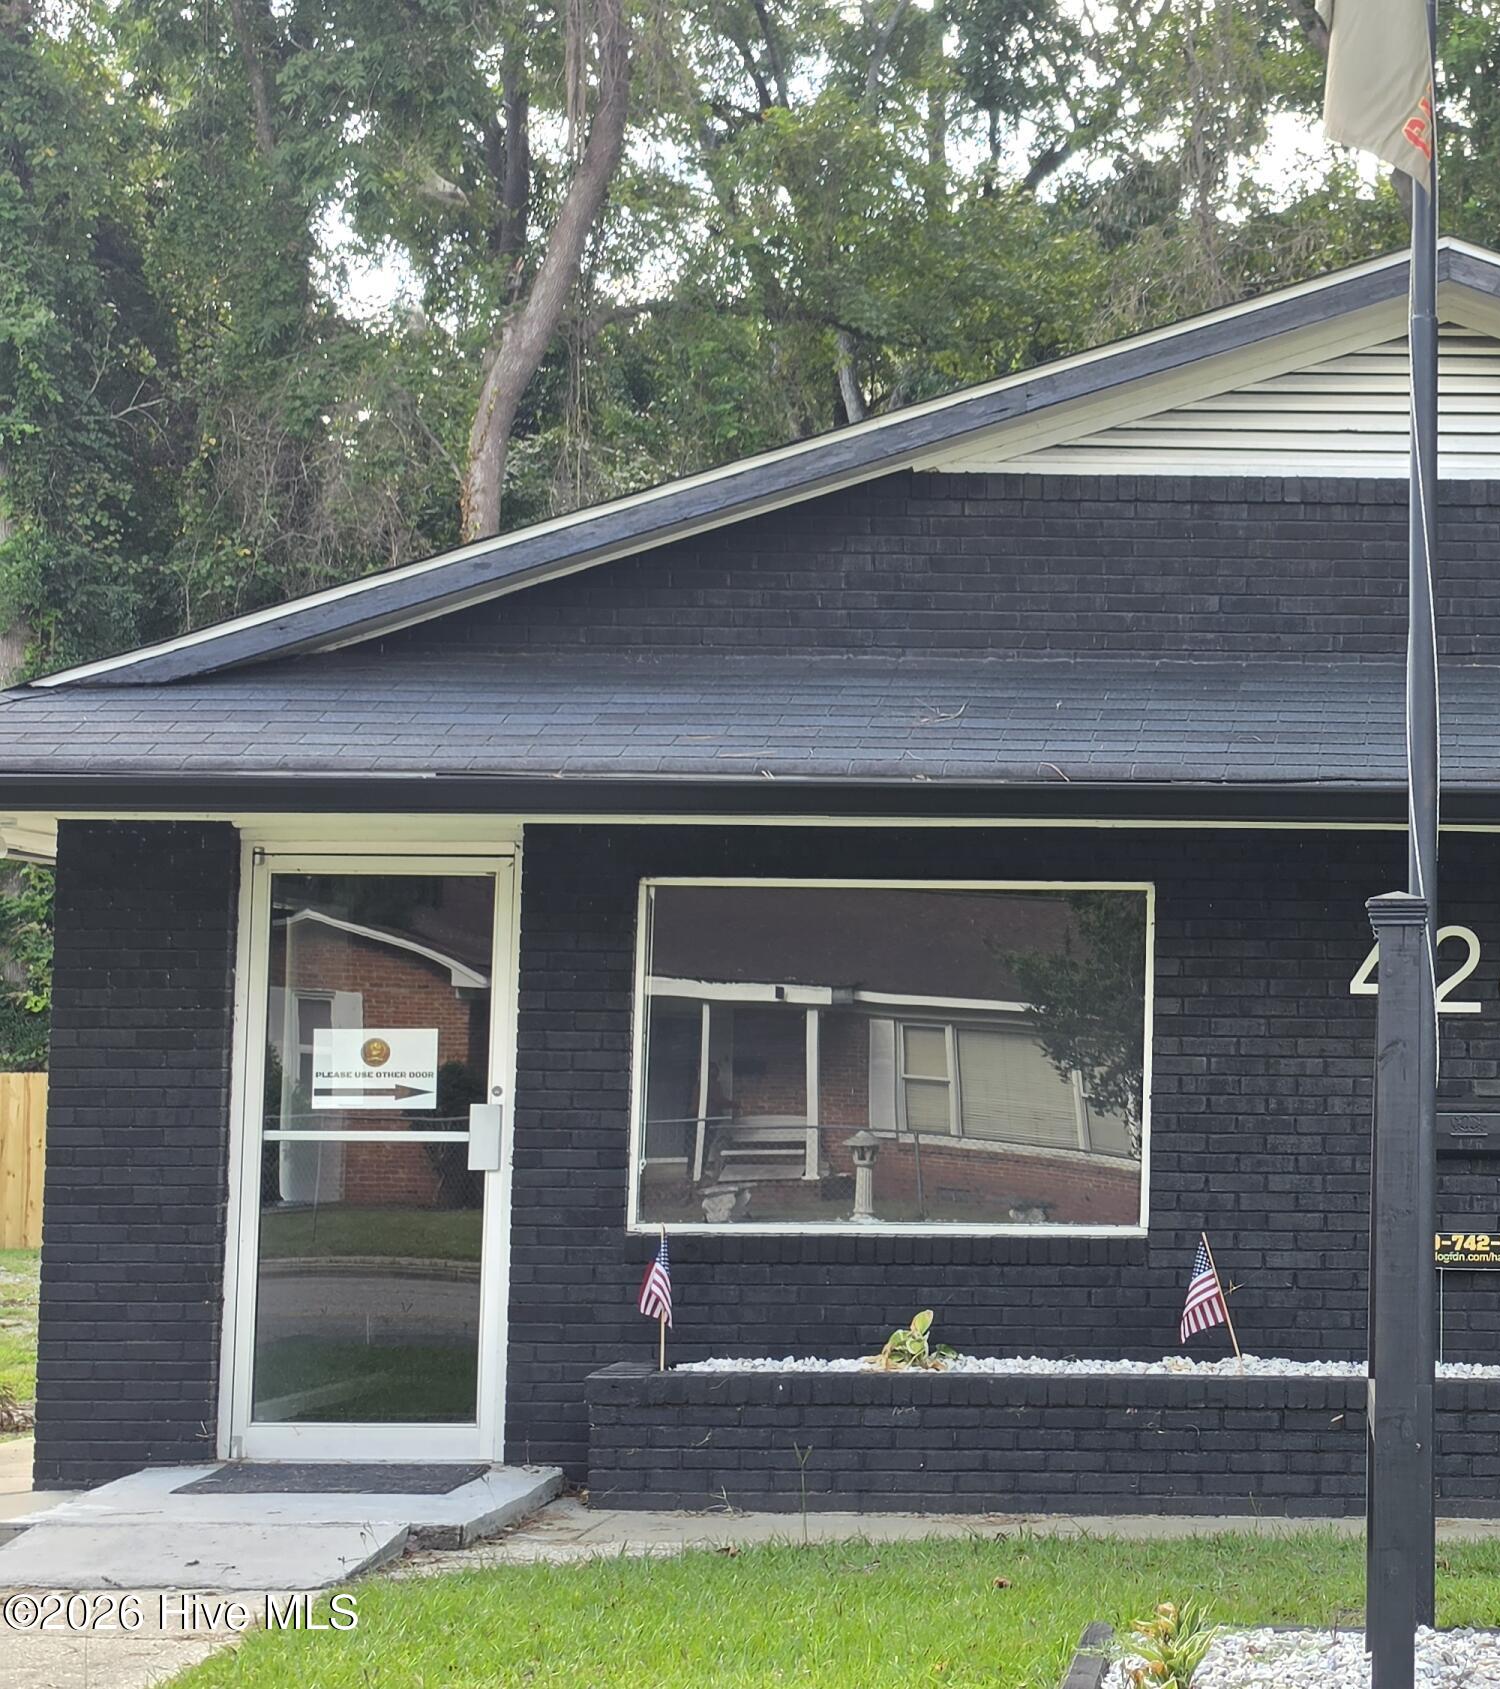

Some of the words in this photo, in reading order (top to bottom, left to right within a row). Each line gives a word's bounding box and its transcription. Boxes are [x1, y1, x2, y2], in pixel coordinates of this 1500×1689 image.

[315, 1071, 352, 1079] PLEASE
[354, 1071, 374, 1079] USE
[375, 1071, 407, 1079] OTHER
[408, 1071, 434, 1079] DOOR
